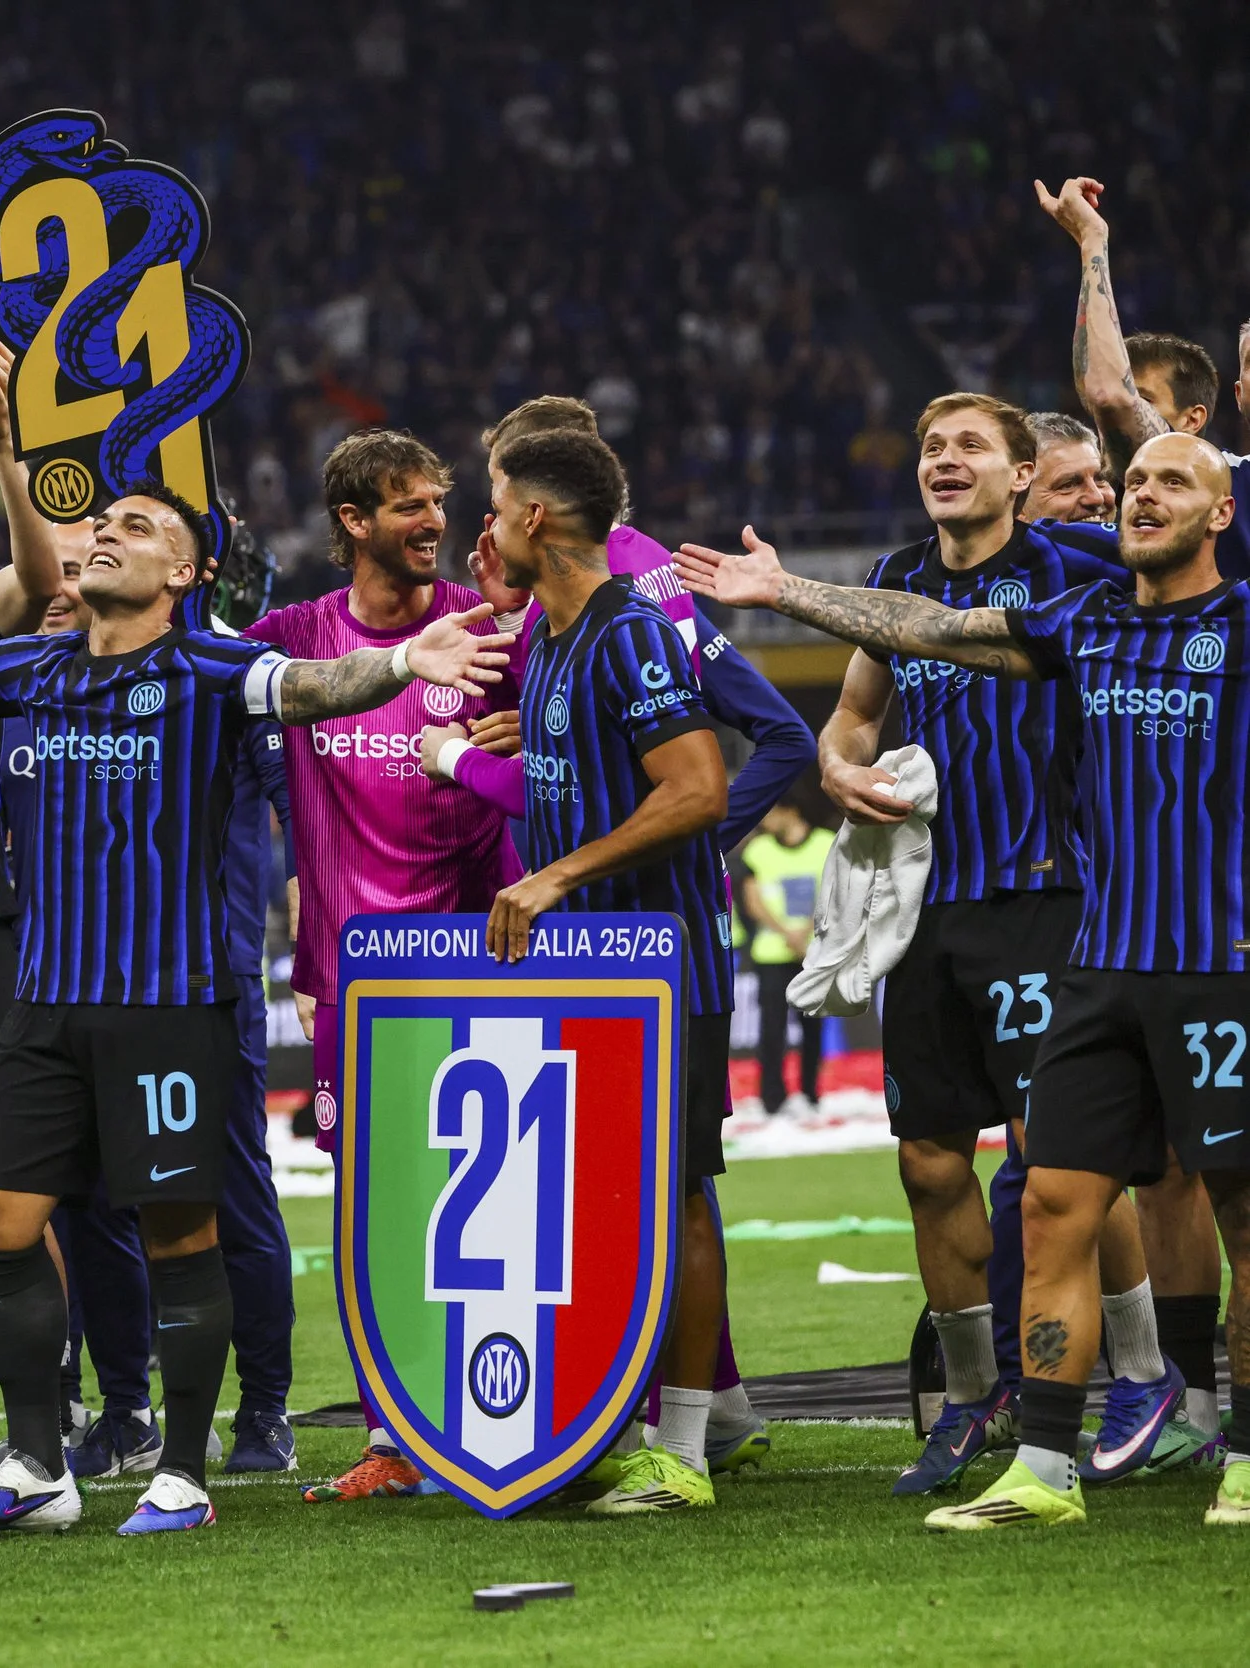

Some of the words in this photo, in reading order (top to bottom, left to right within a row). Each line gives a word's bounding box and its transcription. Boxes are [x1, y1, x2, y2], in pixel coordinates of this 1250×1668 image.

[630, 688, 693, 717] Gate.io
[1080, 679, 1214, 719] betsson
[36, 726, 160, 761] betsson
[312, 724, 423, 759] betsso
[1136, 719, 1212, 741] .sport
[89, 762, 159, 784] .sport
[522, 742, 578, 782] tsson
[346, 928, 478, 958] CAMPIONI
[599, 925, 674, 962] 25/26
[987, 972, 1053, 1043] 23
[1183, 1020, 1248, 1089] 32
[137, 1071, 196, 1135] 10
[433, 1059, 568, 1293] 21
